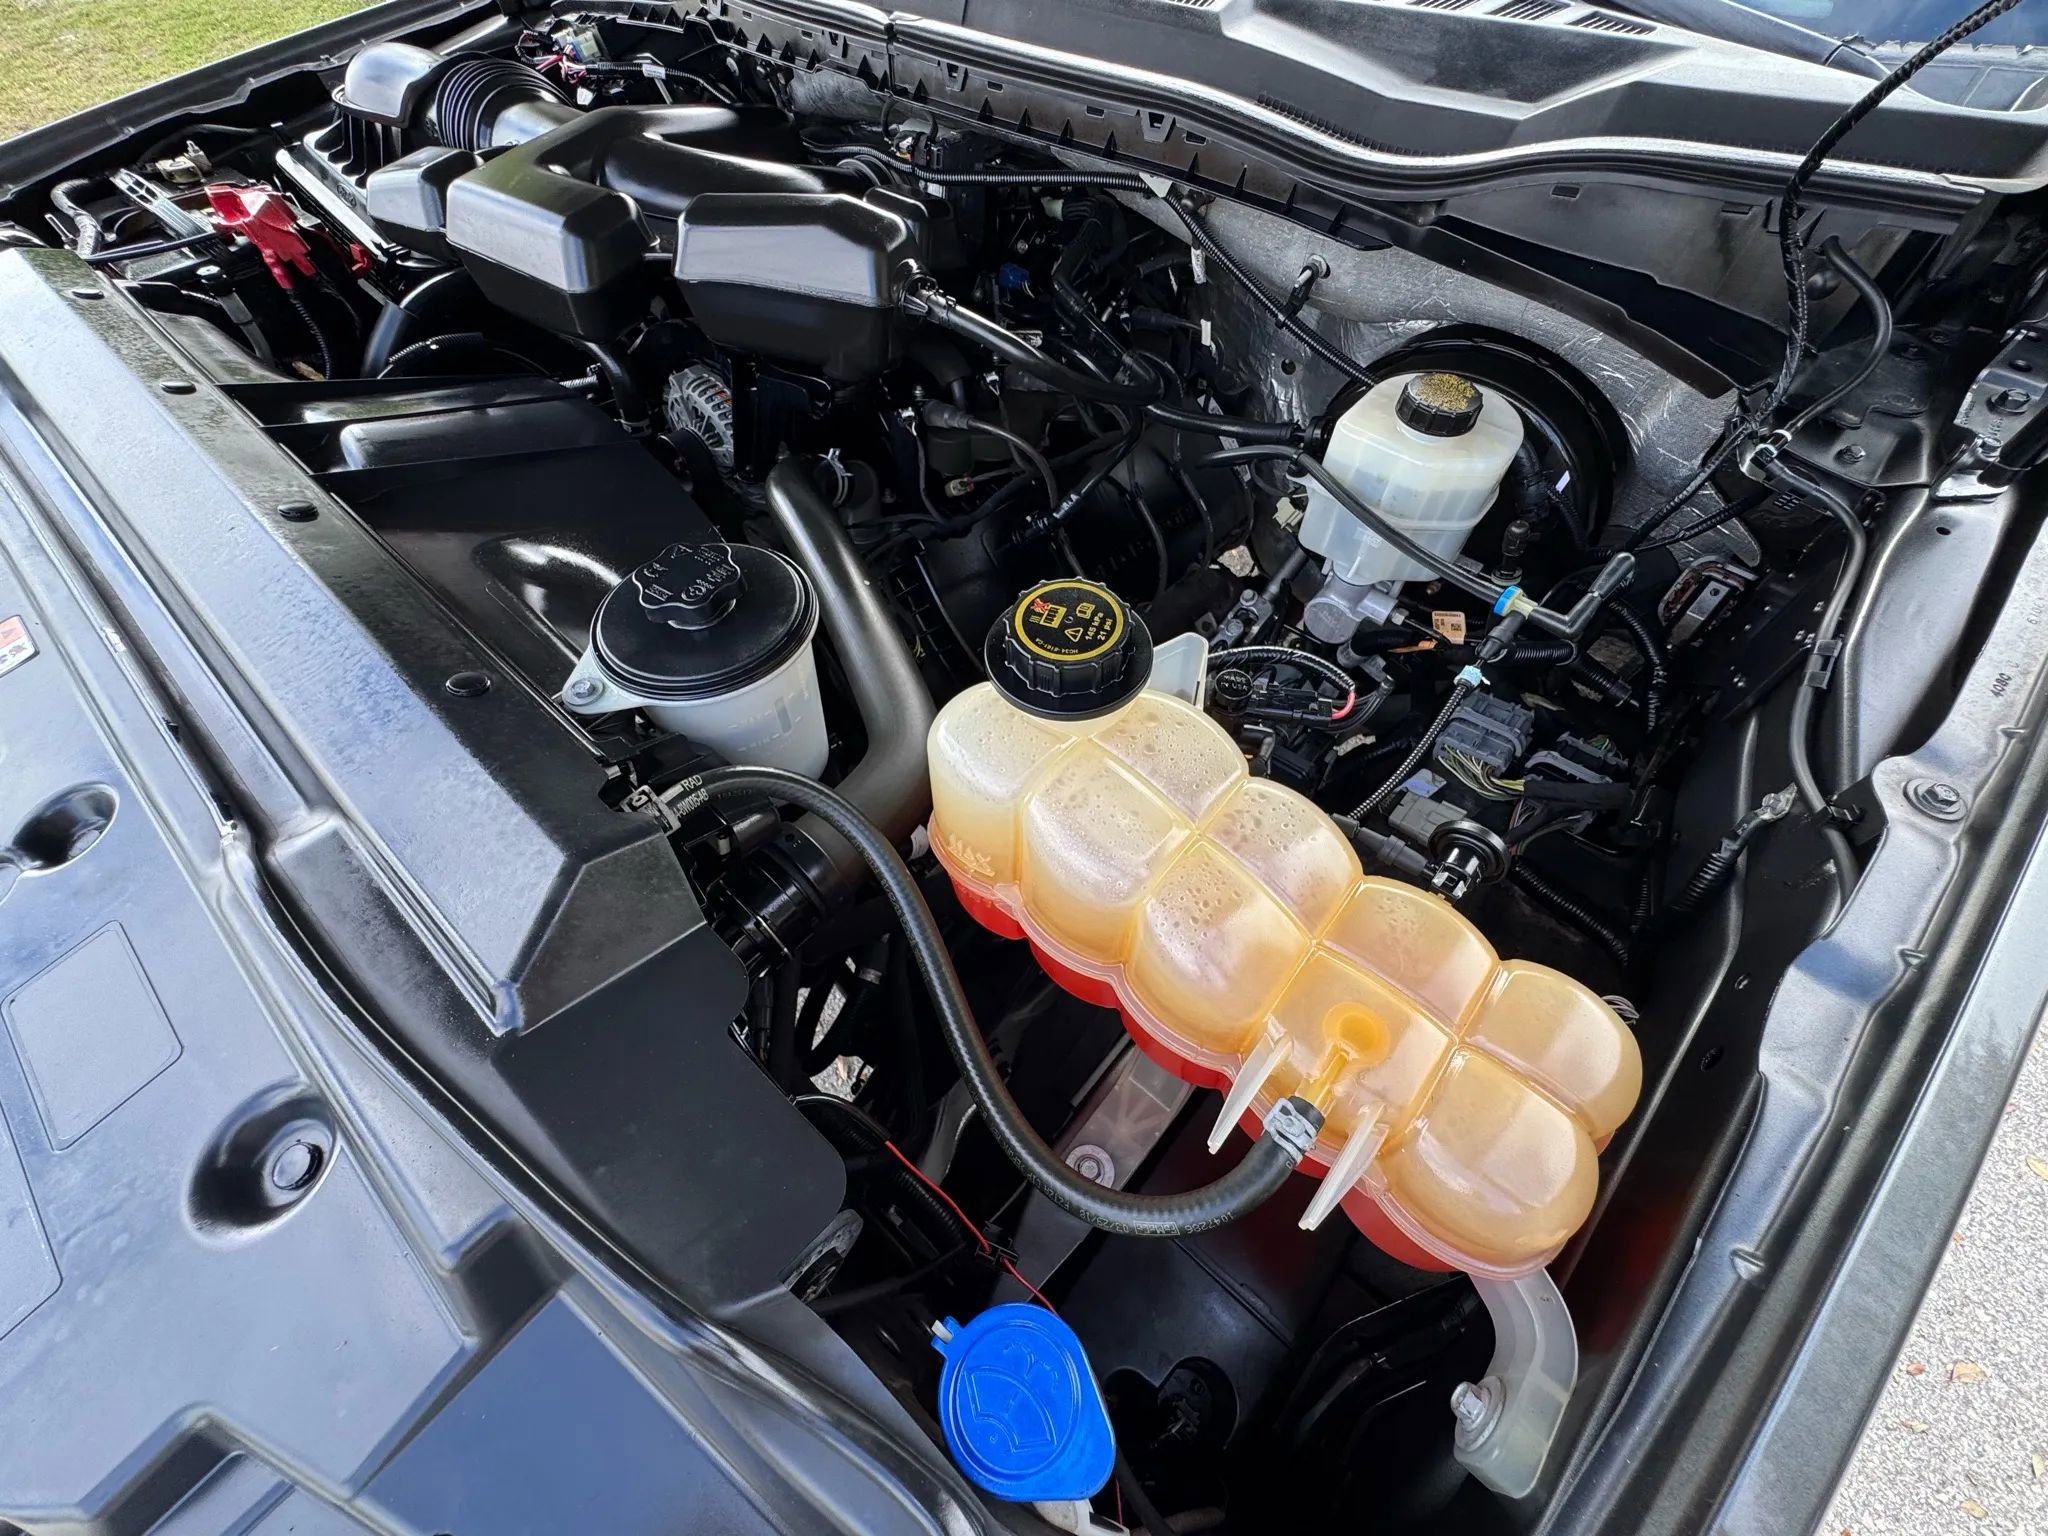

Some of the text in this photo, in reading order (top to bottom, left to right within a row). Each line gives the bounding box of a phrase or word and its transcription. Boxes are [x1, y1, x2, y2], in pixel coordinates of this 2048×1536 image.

[1085, 612, 1104, 640] 145 kPa
[1098, 618, 1113, 641] 21 psi
[681, 774, 703, 791] RAD
[948, 833, 992, 872] MAX
